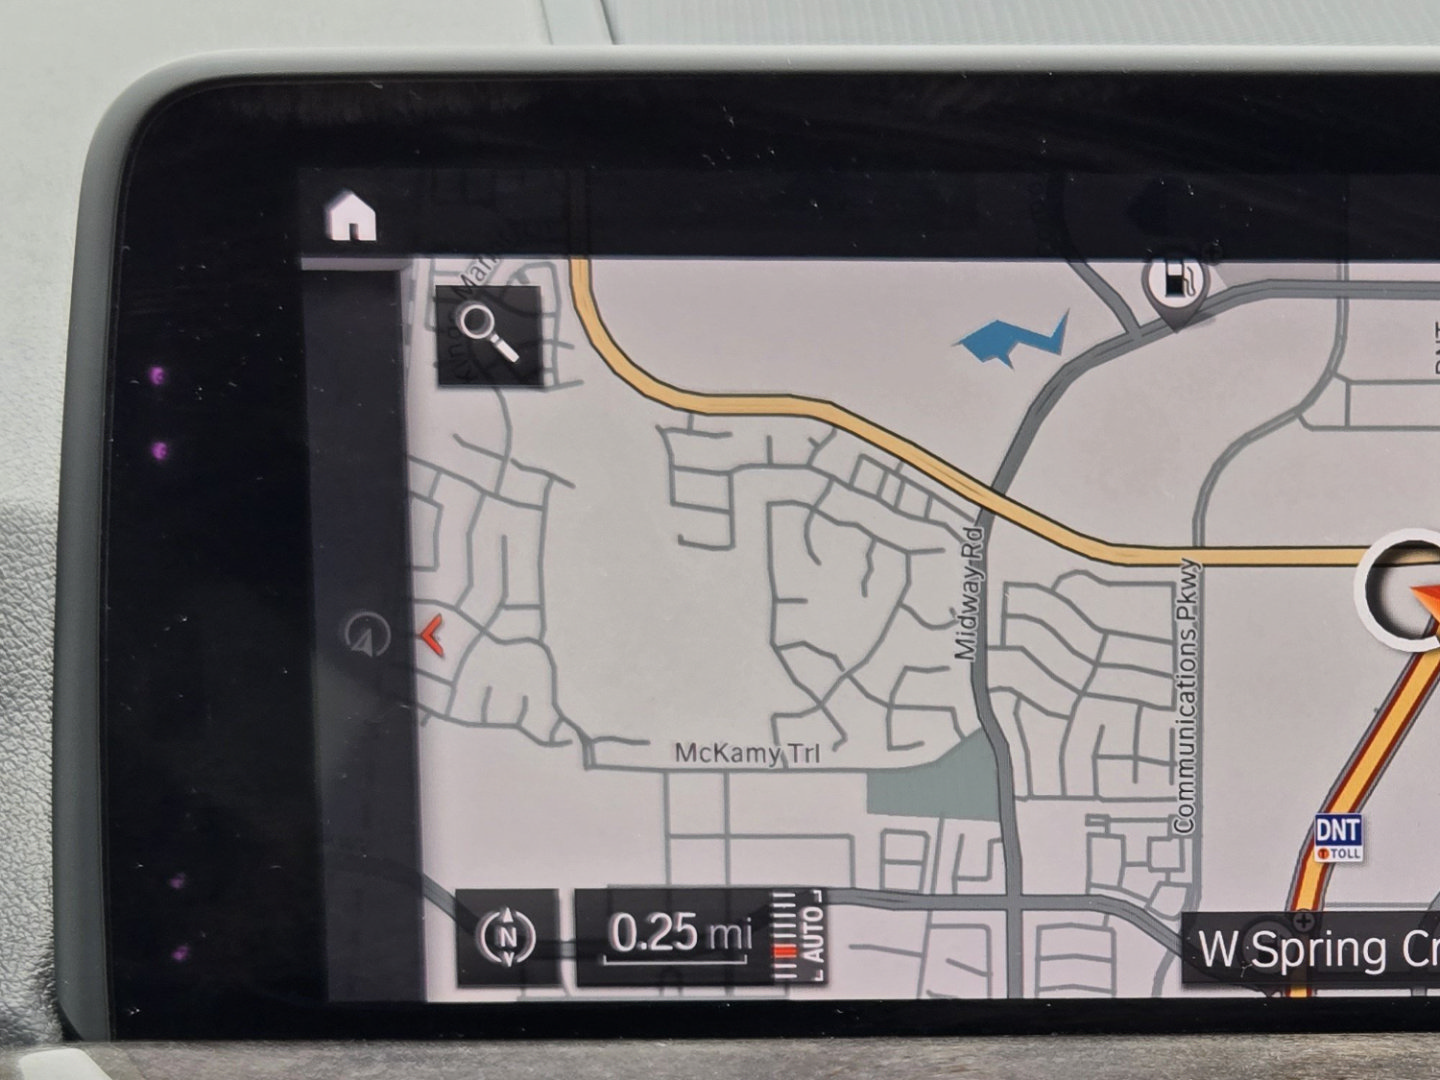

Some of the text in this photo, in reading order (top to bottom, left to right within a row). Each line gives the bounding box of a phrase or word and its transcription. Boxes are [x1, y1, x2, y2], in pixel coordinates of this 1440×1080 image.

[954, 526, 985, 661] Midway Rd
[1174, 558, 1202, 833] Communications Pkwy
[675, 742, 820, 768] McKamy Trl
[1317, 818, 1361, 841] DNT
[1331, 848, 1360, 859] TOLL
[610, 911, 753, 951] 0.25 mi
[803, 906, 824, 963] AUTO
[1199, 930, 1239, 967] W
[1251, 930, 1386, 975] Spring
